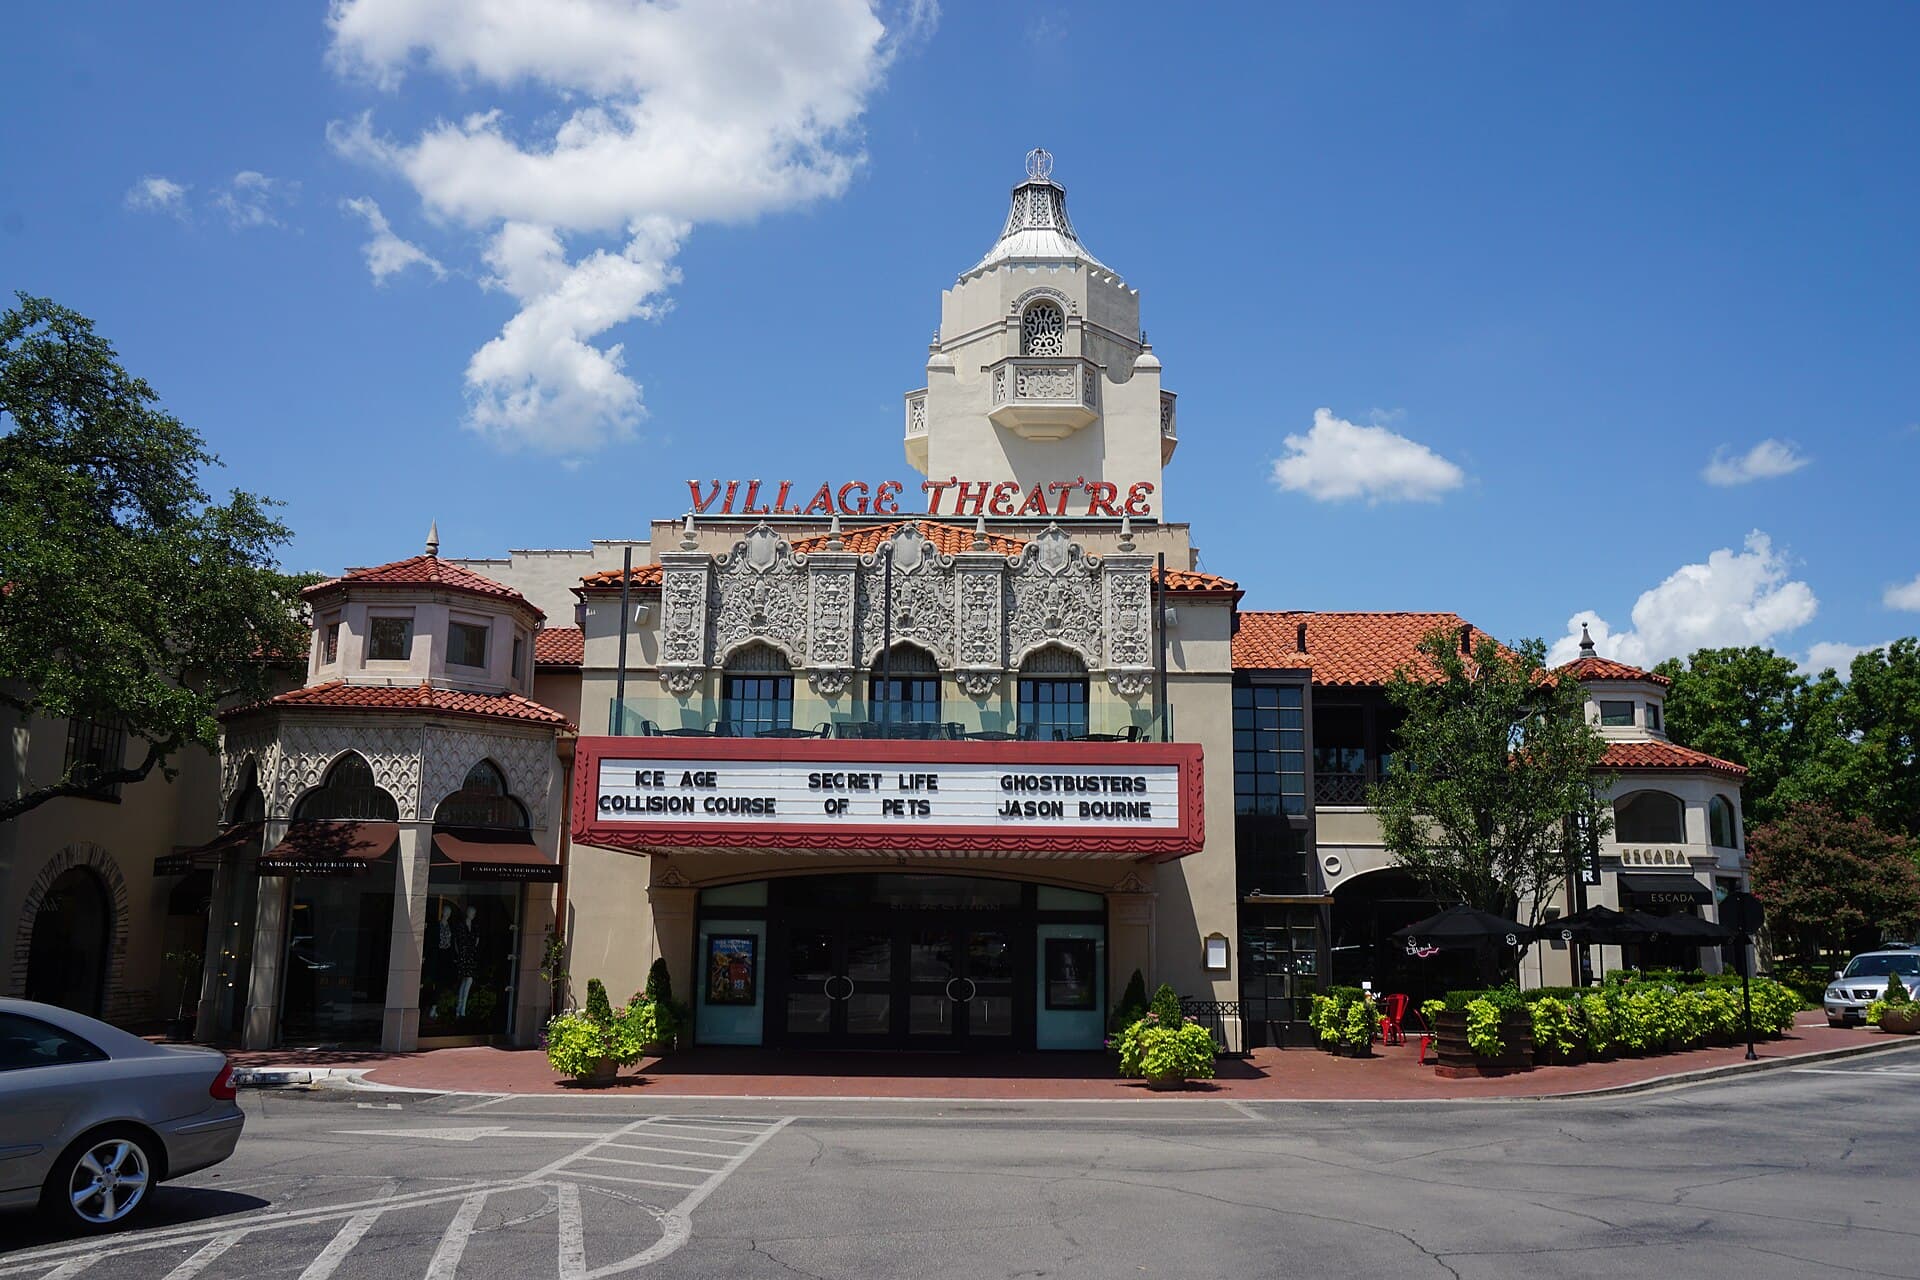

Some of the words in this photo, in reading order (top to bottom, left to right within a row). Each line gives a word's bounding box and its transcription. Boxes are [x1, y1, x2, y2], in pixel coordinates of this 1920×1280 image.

[685, 479, 902, 515] VILLAGE
[922, 476, 1155, 516] THEATRE
[635, 771, 665, 787] ICE
[680, 771, 717, 787] AGE
[808, 773, 882, 789] SECRET
[899, 773, 937, 790] LIFE
[1000, 775, 1147, 793] GHOSTBUSTERS
[599, 795, 695, 813] COLLISION
[703, 797, 776, 814] COURSE
[824, 799, 849, 814] OF
[882, 799, 931, 816] PETS
[998, 801, 1063, 818] JASON
[1079, 801, 1151, 818] BOURNE
[1624, 848, 1685, 865] ESCADA
[1651, 893, 1695, 903] ESCADA
